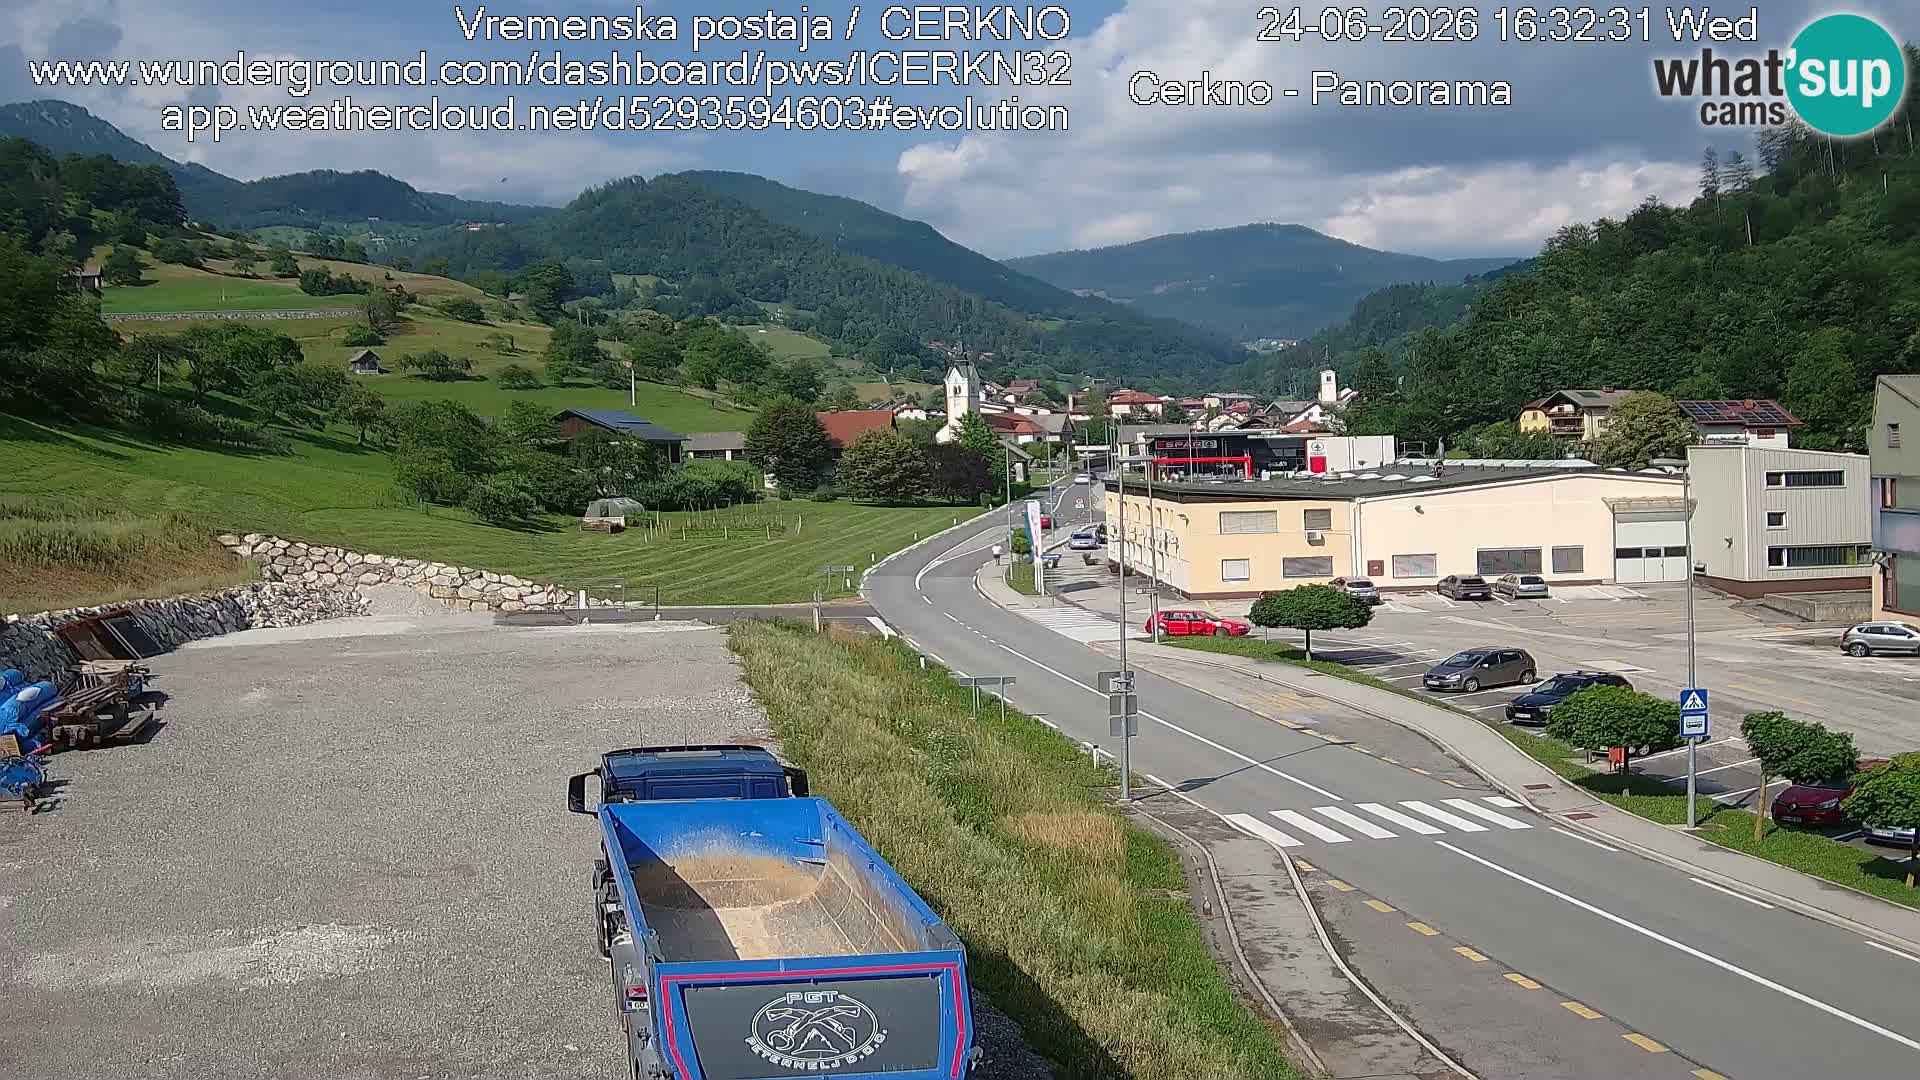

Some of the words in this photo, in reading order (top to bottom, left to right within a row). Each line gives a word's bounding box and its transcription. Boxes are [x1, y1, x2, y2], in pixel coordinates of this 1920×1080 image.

[1165, 440, 1202, 449] SPAR
[785, 990, 839, 1005] PGT
[744, 1035, 842, 1071] PETERNELJ
